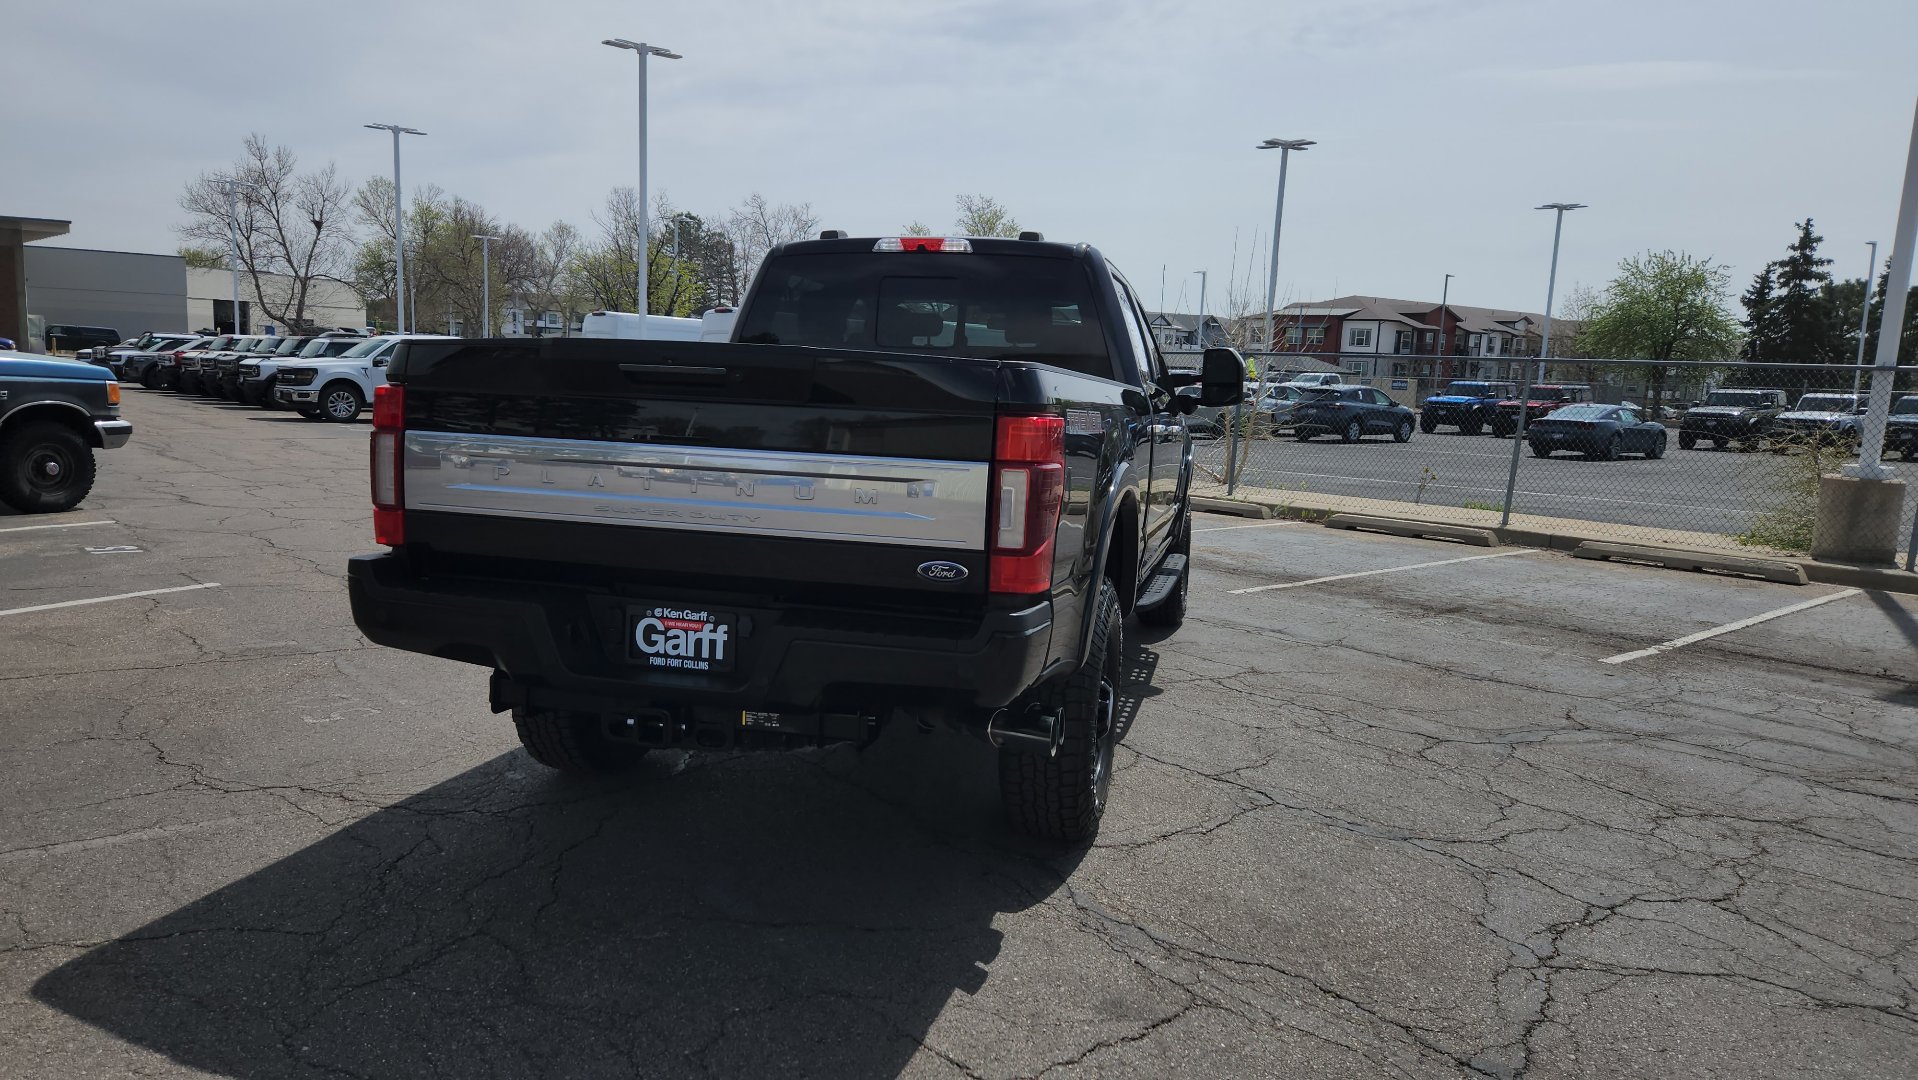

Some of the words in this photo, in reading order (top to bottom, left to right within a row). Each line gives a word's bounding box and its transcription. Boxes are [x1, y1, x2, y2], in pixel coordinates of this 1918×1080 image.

[493, 465, 878, 505] PLATINUM
[593, 504, 683, 518] SUPER
[690, 511, 761, 523] DUTY
[928, 564, 957, 578] Ford
[663, 607, 682, 619] Ken
[683, 610, 708, 621] Garff
[635, 617, 728, 660] Garff
[649, 656, 666, 666] FORD
[667, 658, 682, 668] FORT
[683, 659, 709, 670] COLLINS
